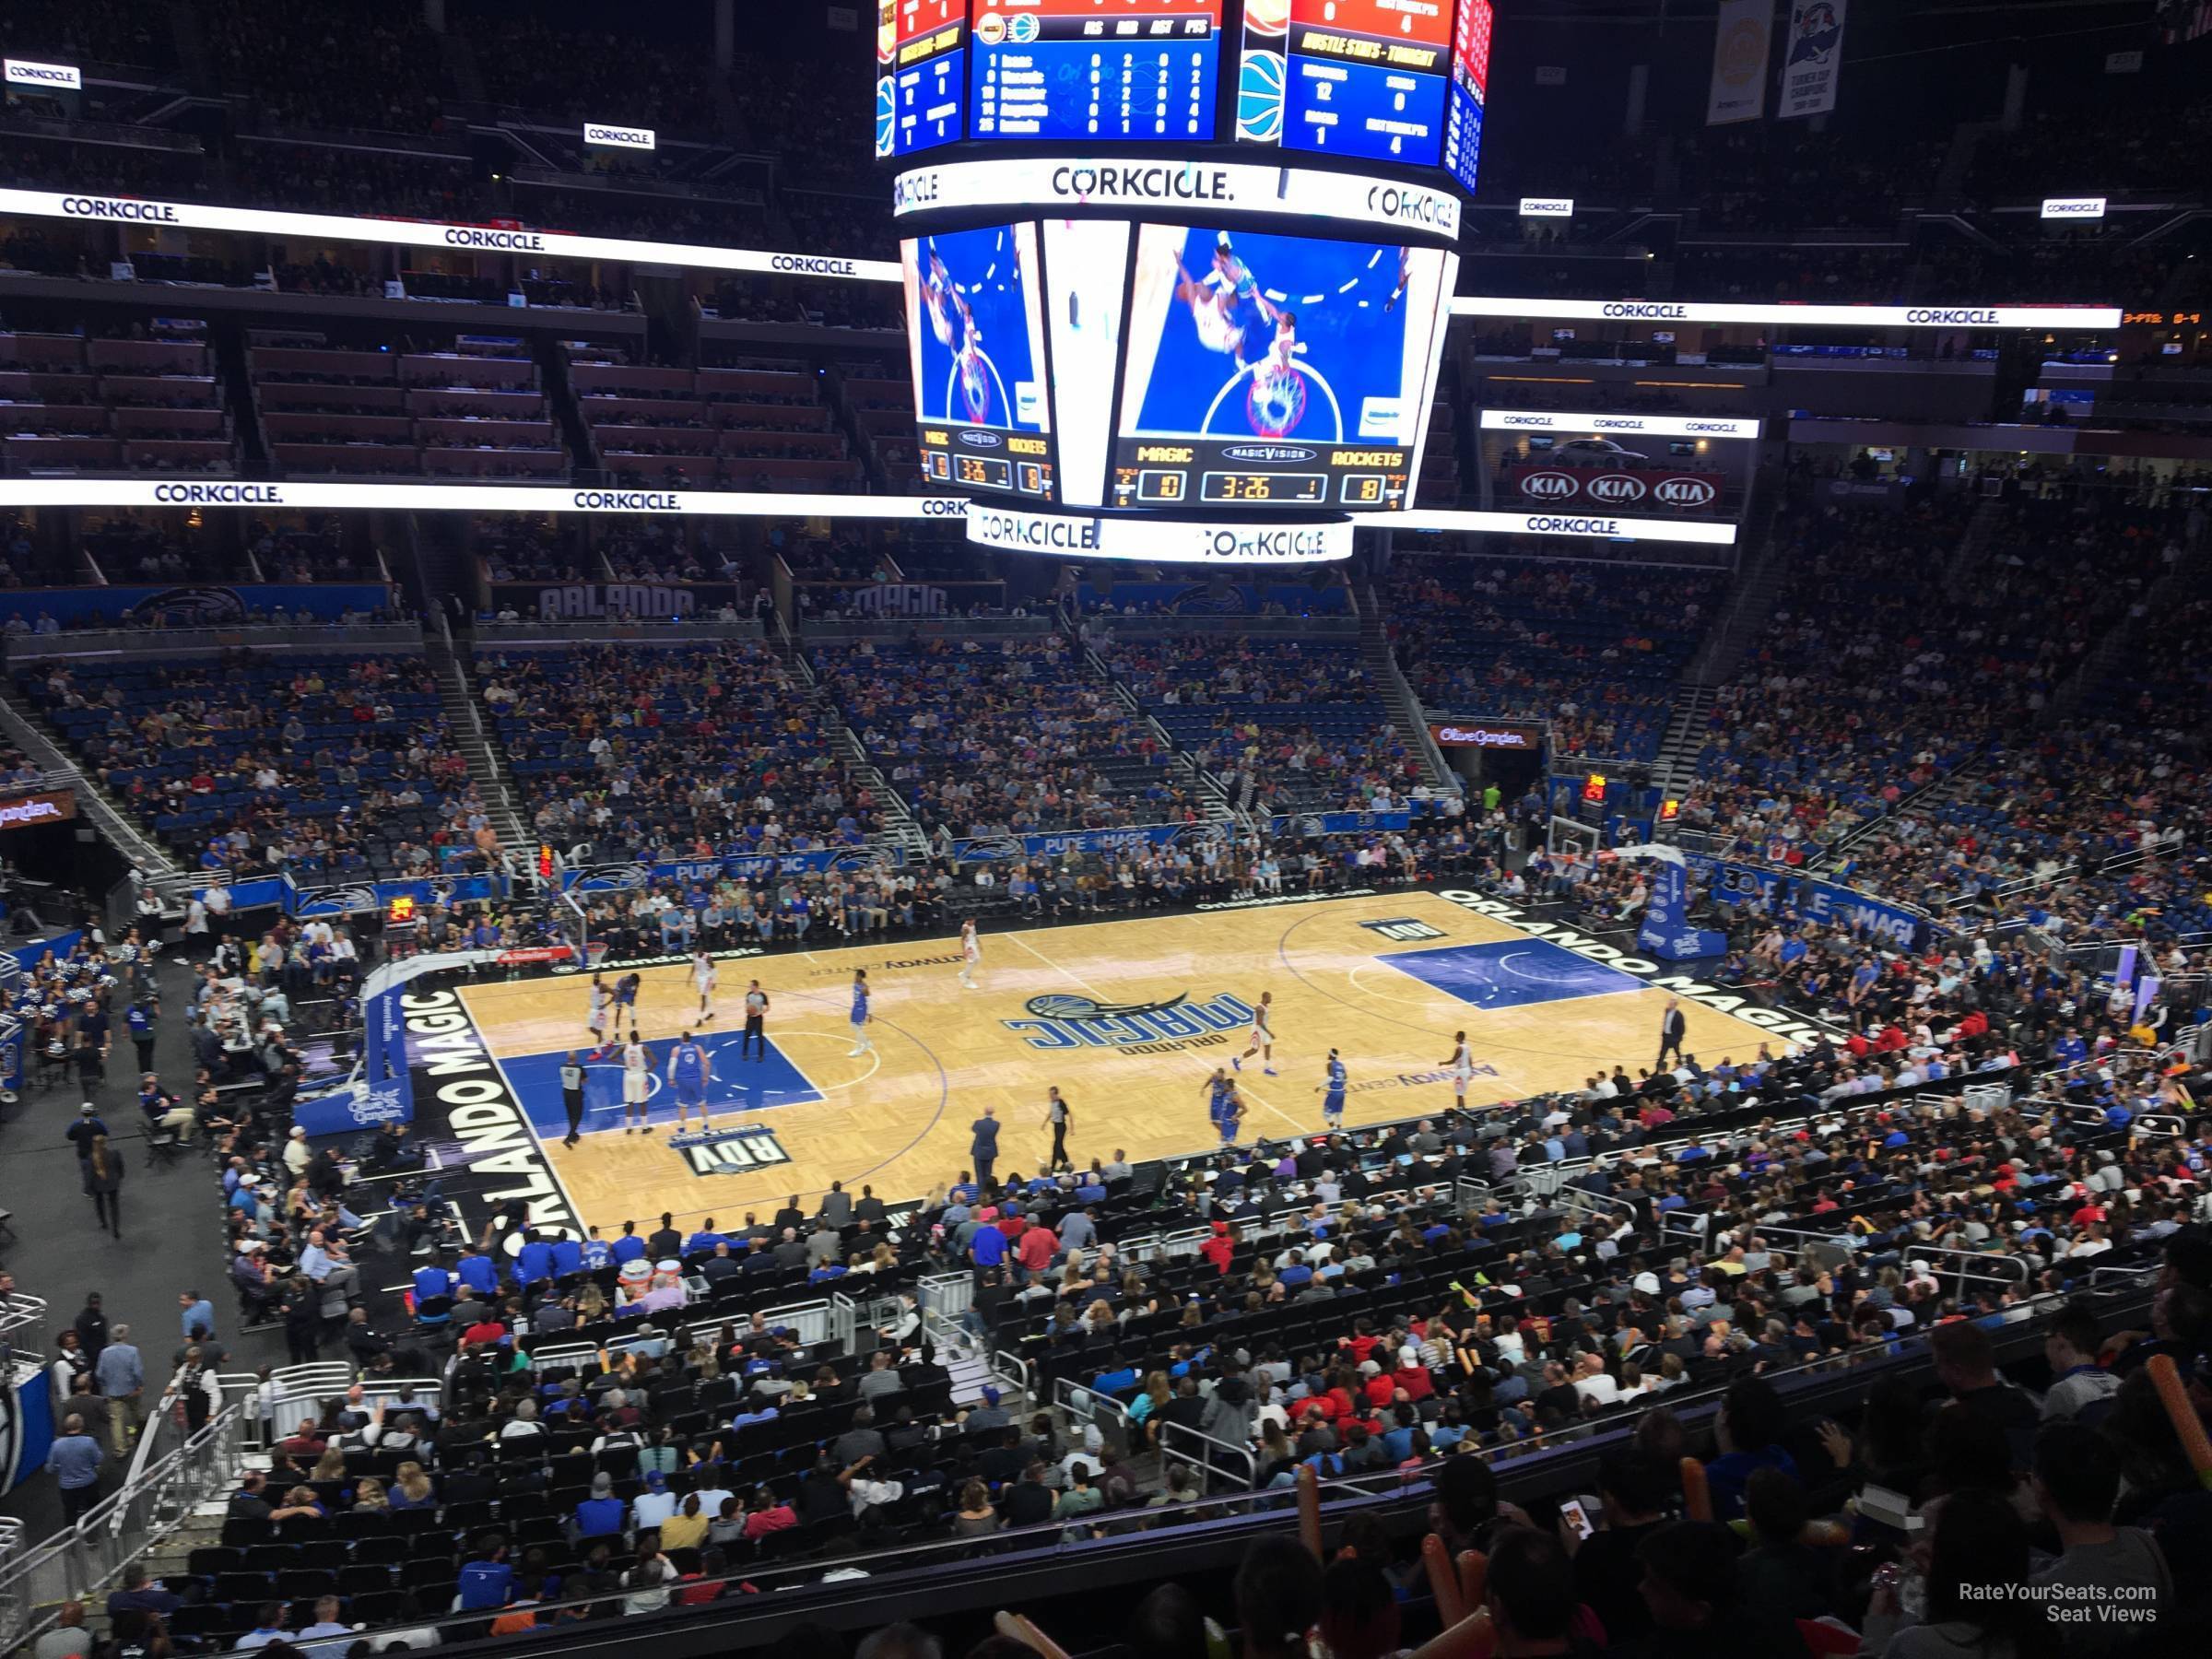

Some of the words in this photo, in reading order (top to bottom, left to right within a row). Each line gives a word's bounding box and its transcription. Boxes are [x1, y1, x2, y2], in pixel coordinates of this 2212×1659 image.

[1053, 166, 1235, 201] CORKCICLE.
[63, 197, 179, 222] CORKCICLE.
[446, 229, 545, 251] CORKCICLE.
[772, 255, 856, 276] CORKCICLE.
[1603, 303, 1687, 318] CORKCICLE.
[1907, 310, 1999, 324] CORKCICLE.
[1137, 447, 1194, 462] MAGIC
[1331, 452, 1403, 466] ROCKETS
[155, 484, 283, 503] CORKCICLE.
[1222, 477, 1269, 499] 3:26
[1531, 478, 1568, 494] KIA
[1596, 480, 1634, 498] KIA
[1665, 484, 1704, 500] KIA
[574, 492, 681, 510] CORKCICLE.
[1440, 727, 1477, 741] Olive
[1194, 888, 1377, 910] OrlandoMagic.com
[1438, 888, 1659, 974] ORLANDO
[1653, 975, 1847, 1047] MAGIC
[400, 990, 491, 1076] MAGIC
[1117, 1033, 1229, 1055] ORLANDO
[690, 1135, 787, 1172] RDV
[589, 1255, 606, 1269] 14
